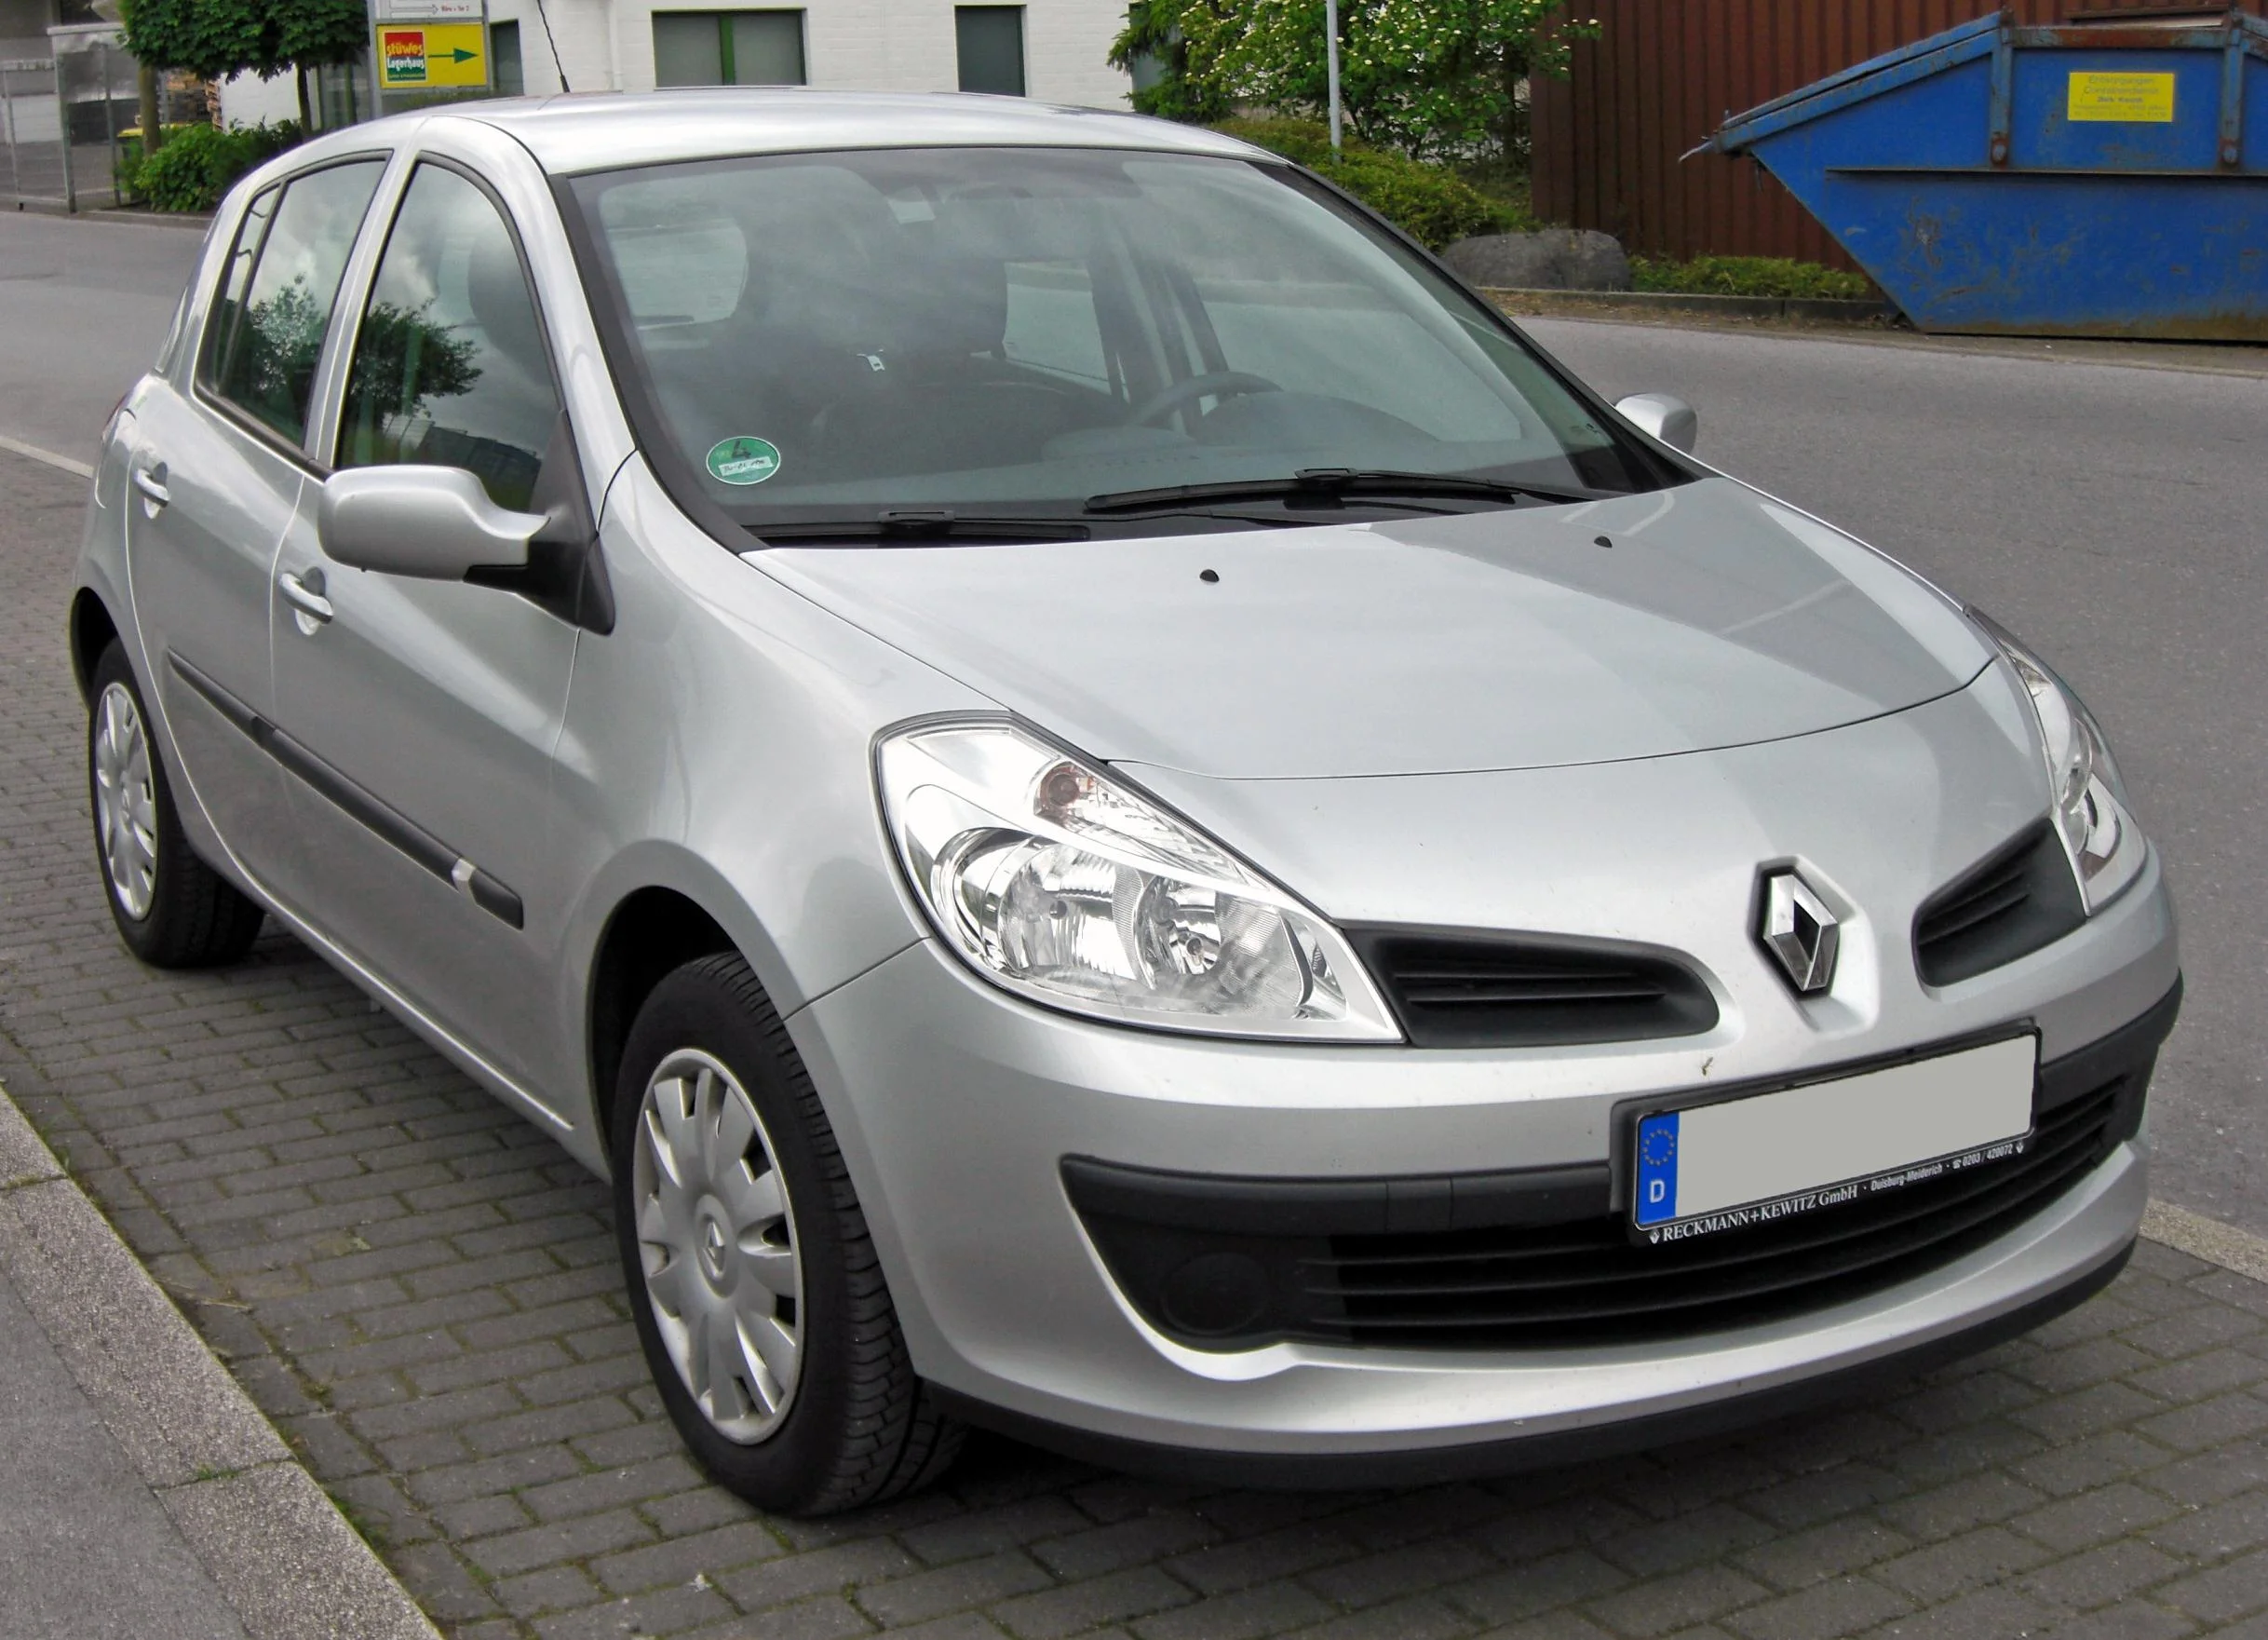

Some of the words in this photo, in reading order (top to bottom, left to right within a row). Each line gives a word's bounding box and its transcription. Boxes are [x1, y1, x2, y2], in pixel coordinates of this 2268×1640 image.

[386, 57, 425, 71] Lagerhaus
[1649, 1179, 1666, 1204] D
[1662, 1194, 1817, 1242] RECKMANN+KEWITZ
[1818, 1184, 1858, 1207] GmbH
[1870, 1163, 1943, 1191] Duisburg-Meiderich
